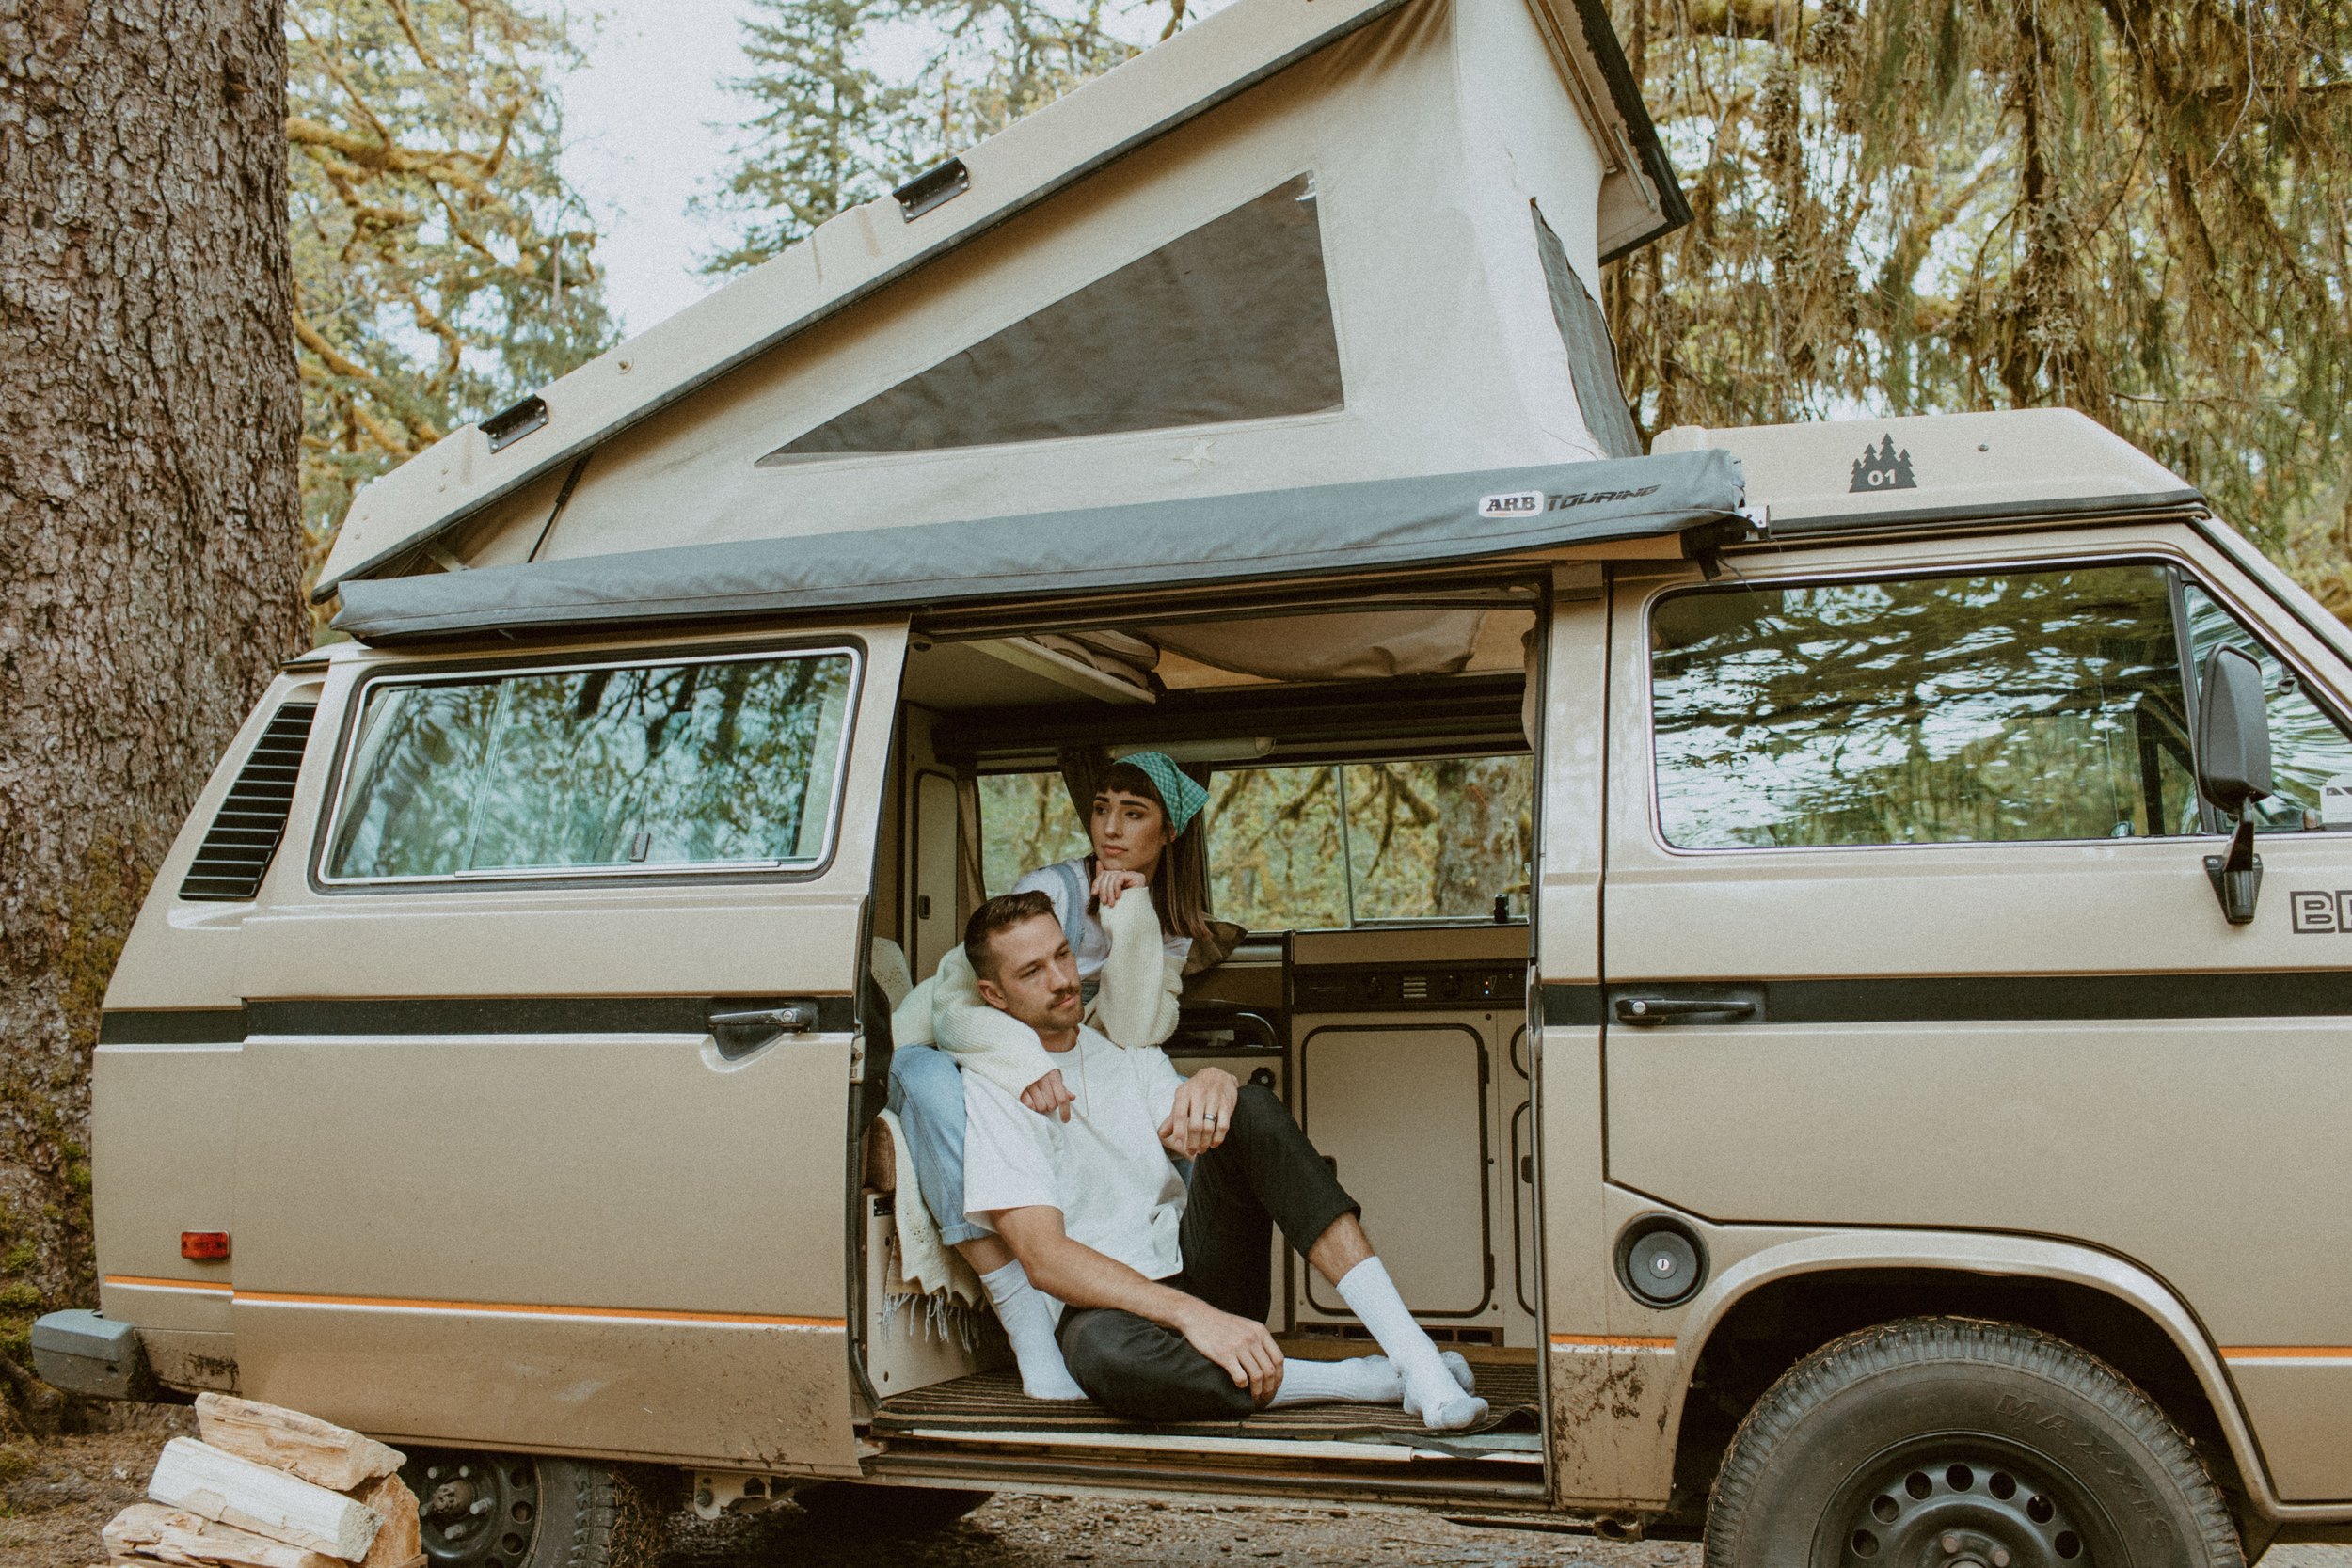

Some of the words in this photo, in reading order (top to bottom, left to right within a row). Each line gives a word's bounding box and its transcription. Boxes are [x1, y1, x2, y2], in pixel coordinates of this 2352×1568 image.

[1867, 469, 1896, 486] 01
[1486, 496, 1535, 512] ARB
[1548, 483, 1661, 511] TOURING
[1994, 1394, 2173, 1547] MAXXIS
